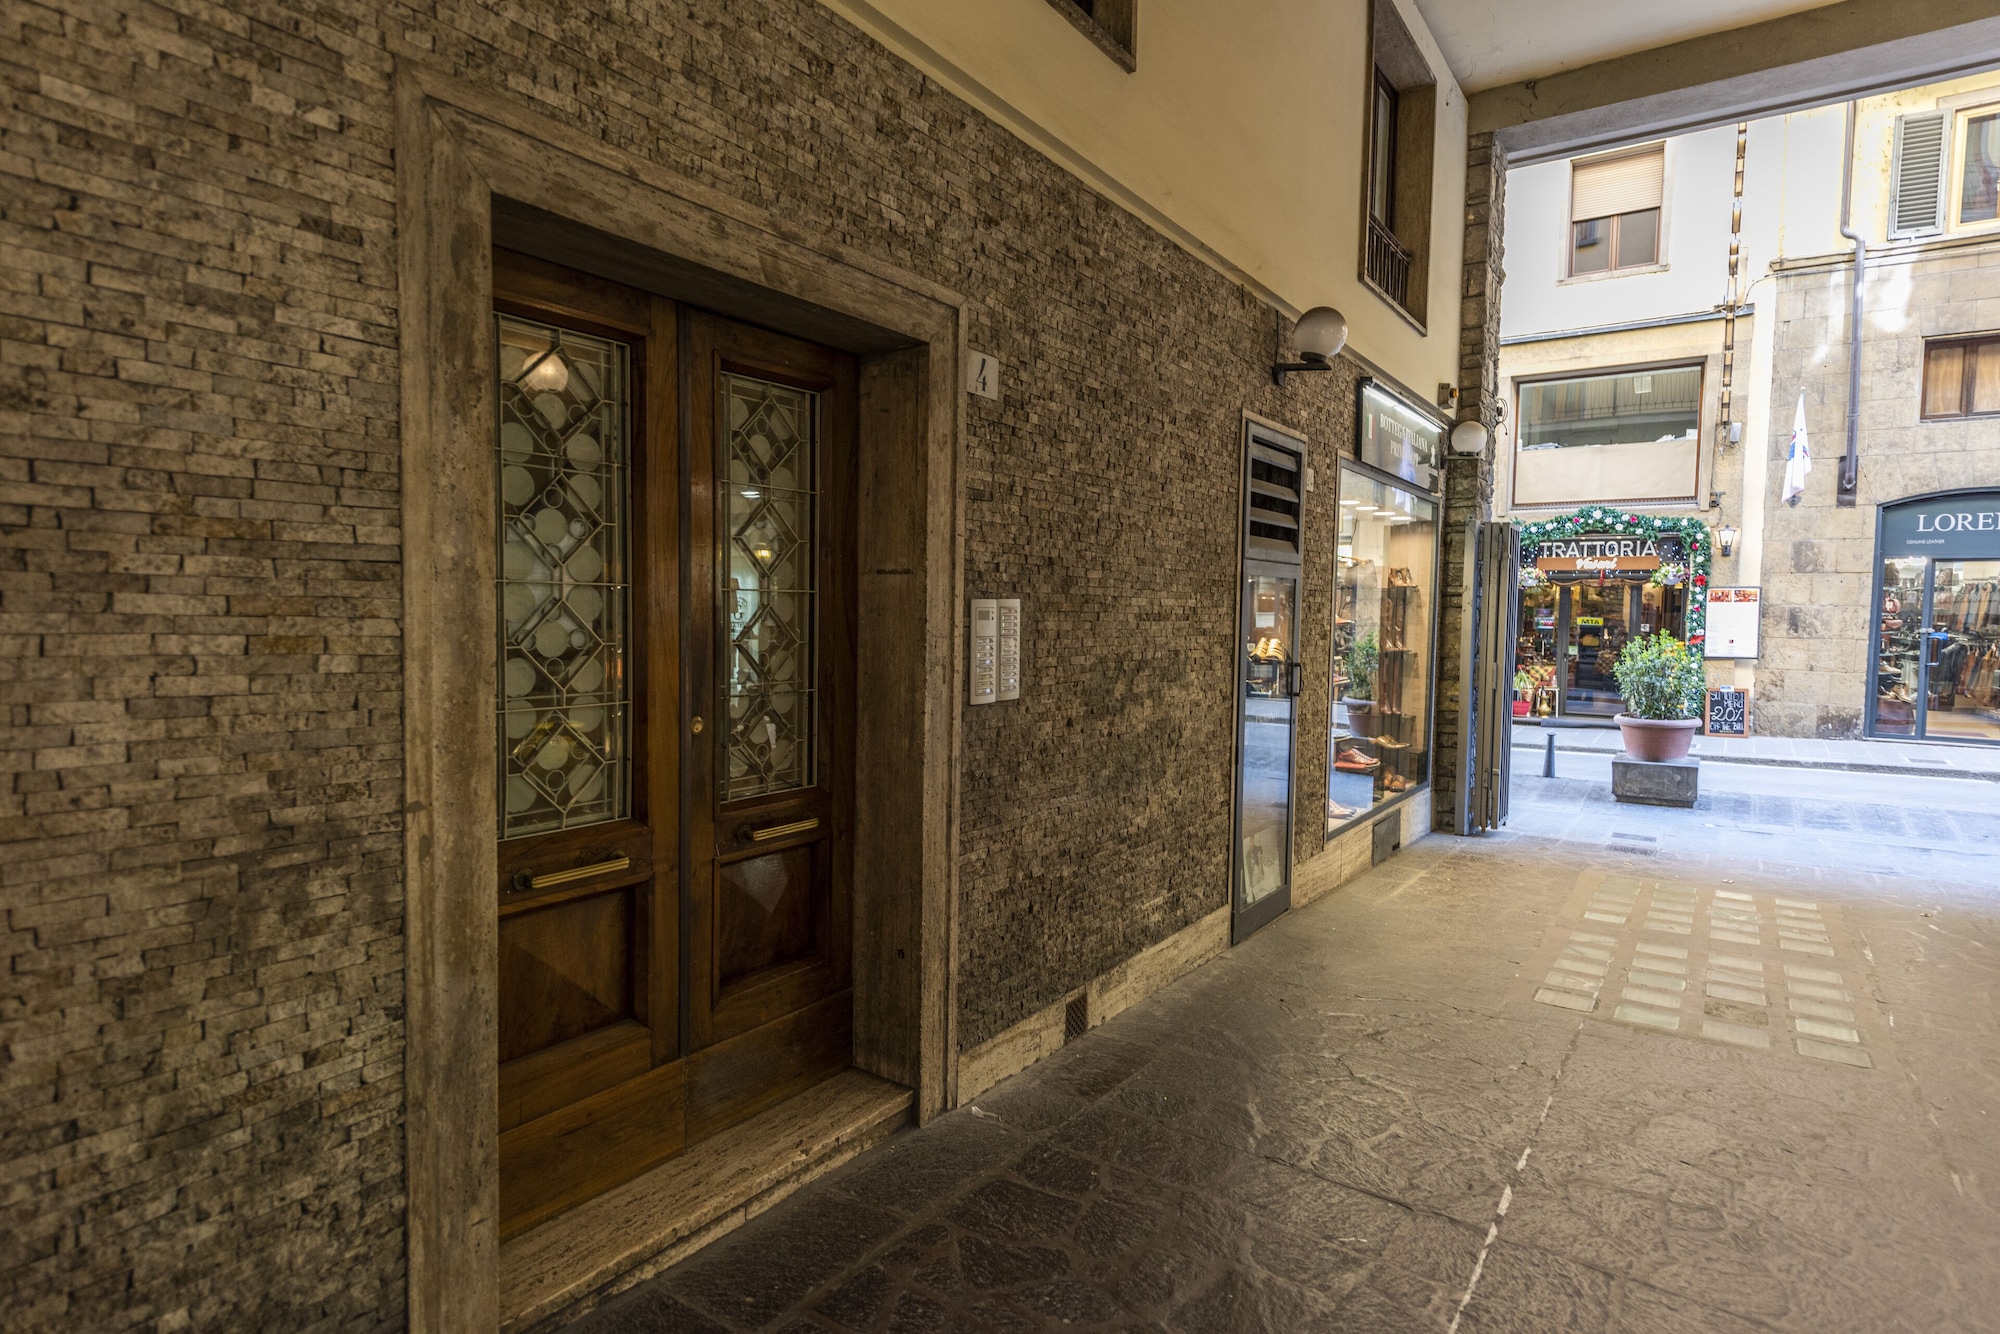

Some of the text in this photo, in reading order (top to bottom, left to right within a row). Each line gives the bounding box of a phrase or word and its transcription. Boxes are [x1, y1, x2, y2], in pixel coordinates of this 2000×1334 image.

[975, 358, 988, 392] 4
[1916, 512, 2000, 532] LORE
[1539, 540, 1658, 558] TRATTORIA
